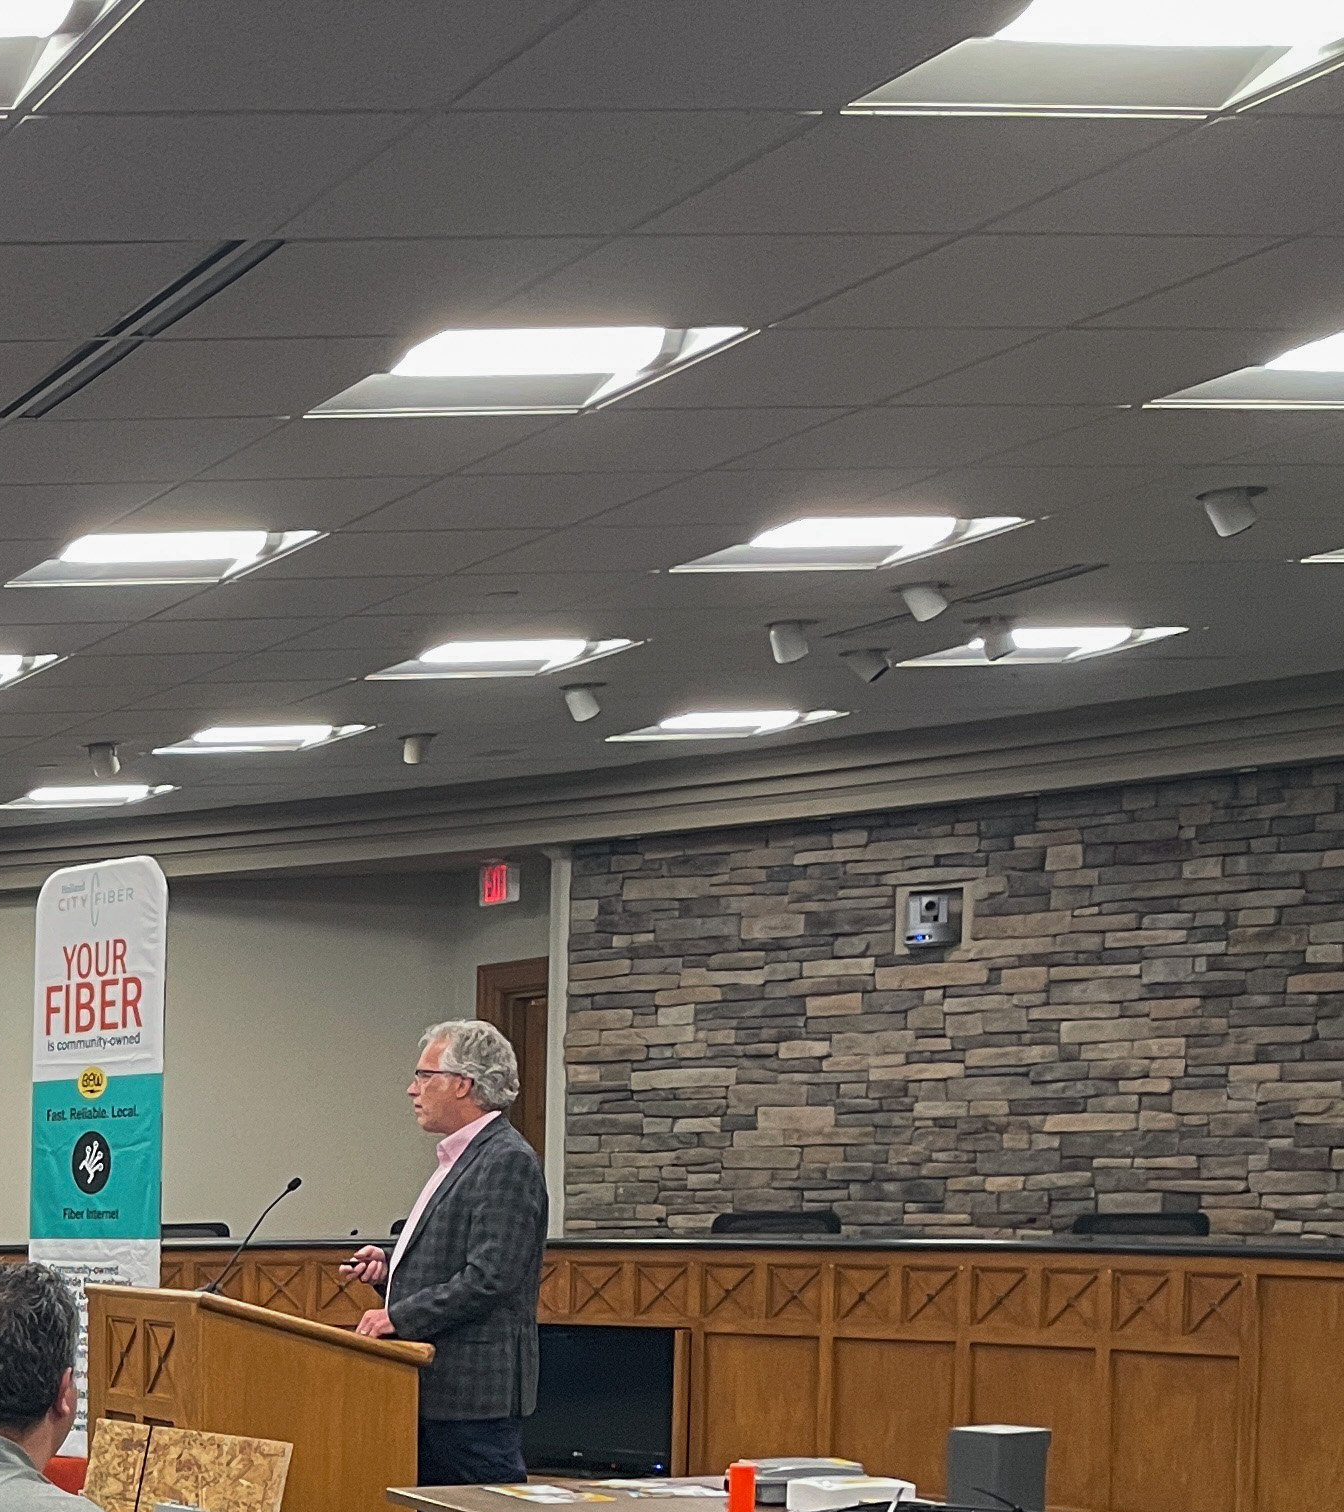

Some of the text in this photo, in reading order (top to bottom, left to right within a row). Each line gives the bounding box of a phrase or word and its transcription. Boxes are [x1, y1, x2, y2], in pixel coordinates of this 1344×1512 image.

[58, 887, 134, 912] CITY FIBER
[62, 938, 127, 981] YOUR
[45, 976, 143, 1036] FIBER
[56, 1032, 141, 1052] community-owned
[63, 1207, 120, 1220] Fiber Internet
